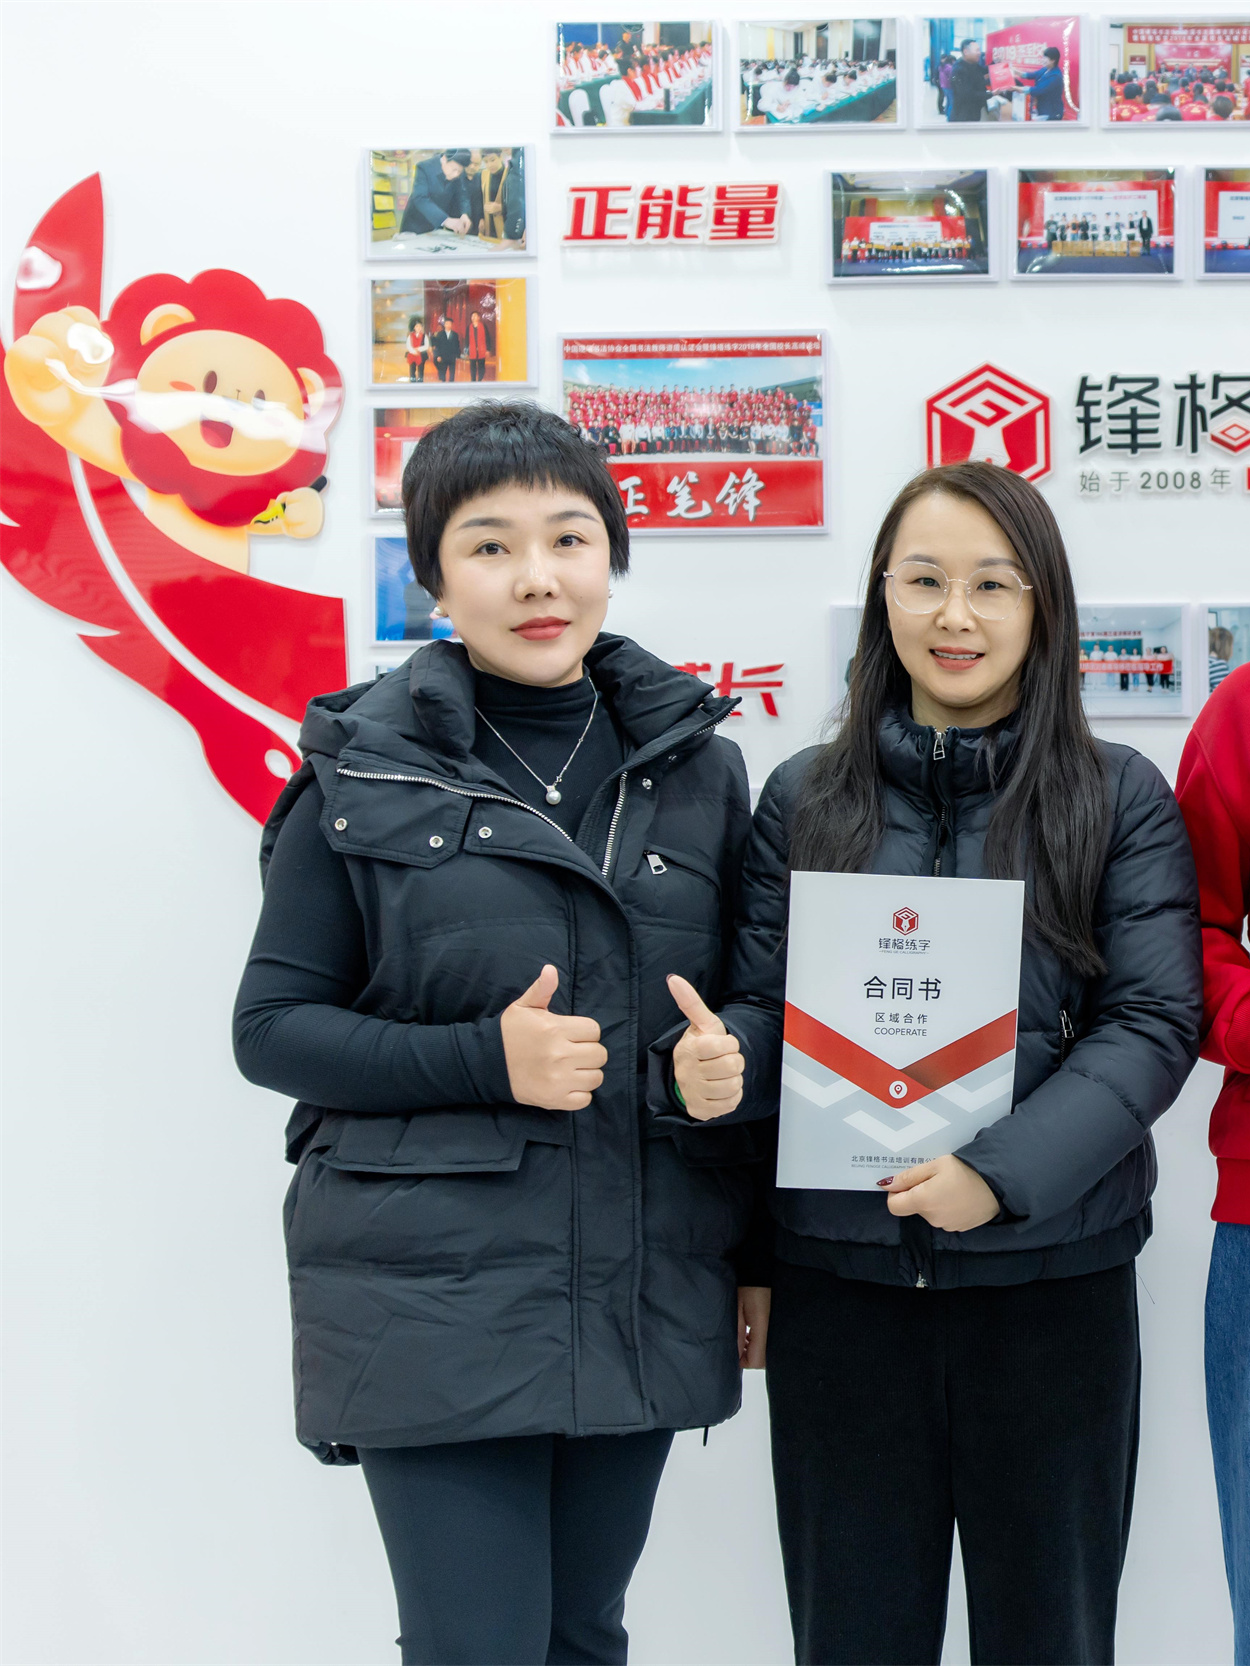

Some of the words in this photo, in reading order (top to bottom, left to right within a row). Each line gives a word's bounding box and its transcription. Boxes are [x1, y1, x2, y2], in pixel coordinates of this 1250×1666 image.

[564, 184, 779, 241] 正能量
[1080, 467, 1230, 493] 始于2008年
[878, 938, 931, 951] 锋格练字
[863, 975, 942, 1001] 合同书
[875, 1012, 928, 1024] 区域合作
[874, 1027, 927, 1037] COOPERATE
